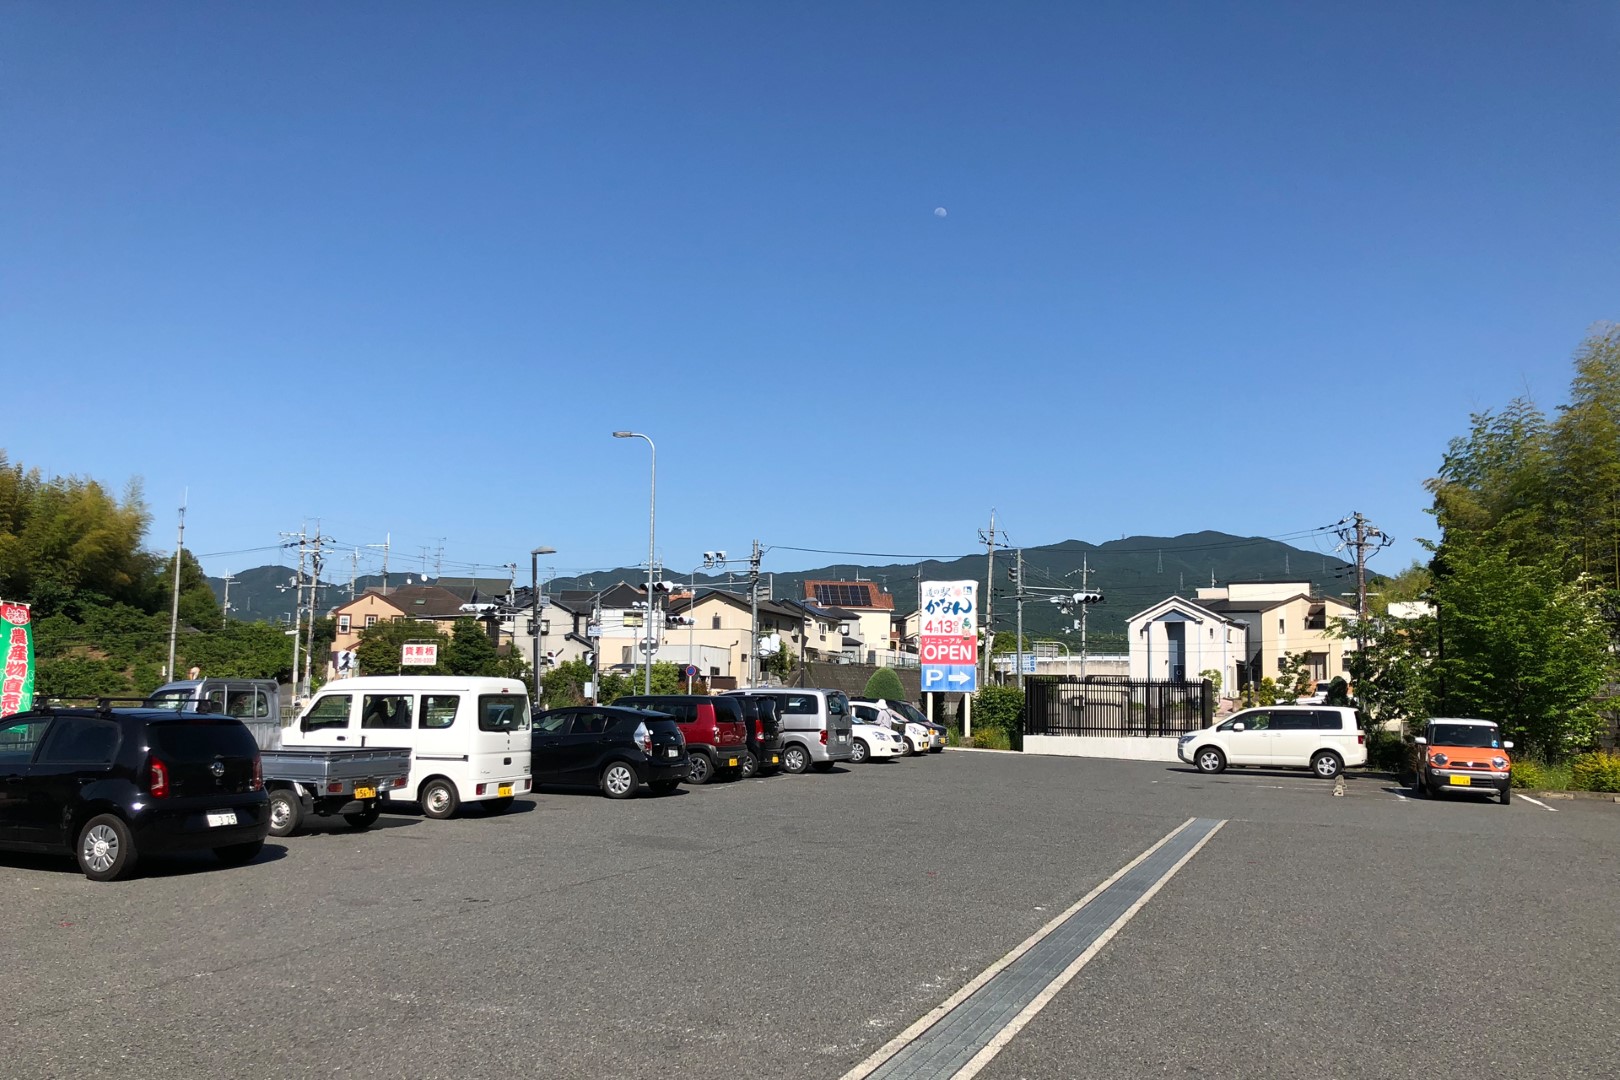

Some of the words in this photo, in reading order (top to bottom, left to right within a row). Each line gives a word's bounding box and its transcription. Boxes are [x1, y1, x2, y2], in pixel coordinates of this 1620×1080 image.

[925, 586, 951, 598] 道の駅
[924, 598, 972, 615] かなん
[923, 644, 972, 660] OPEN
[925, 669, 944, 687] P
